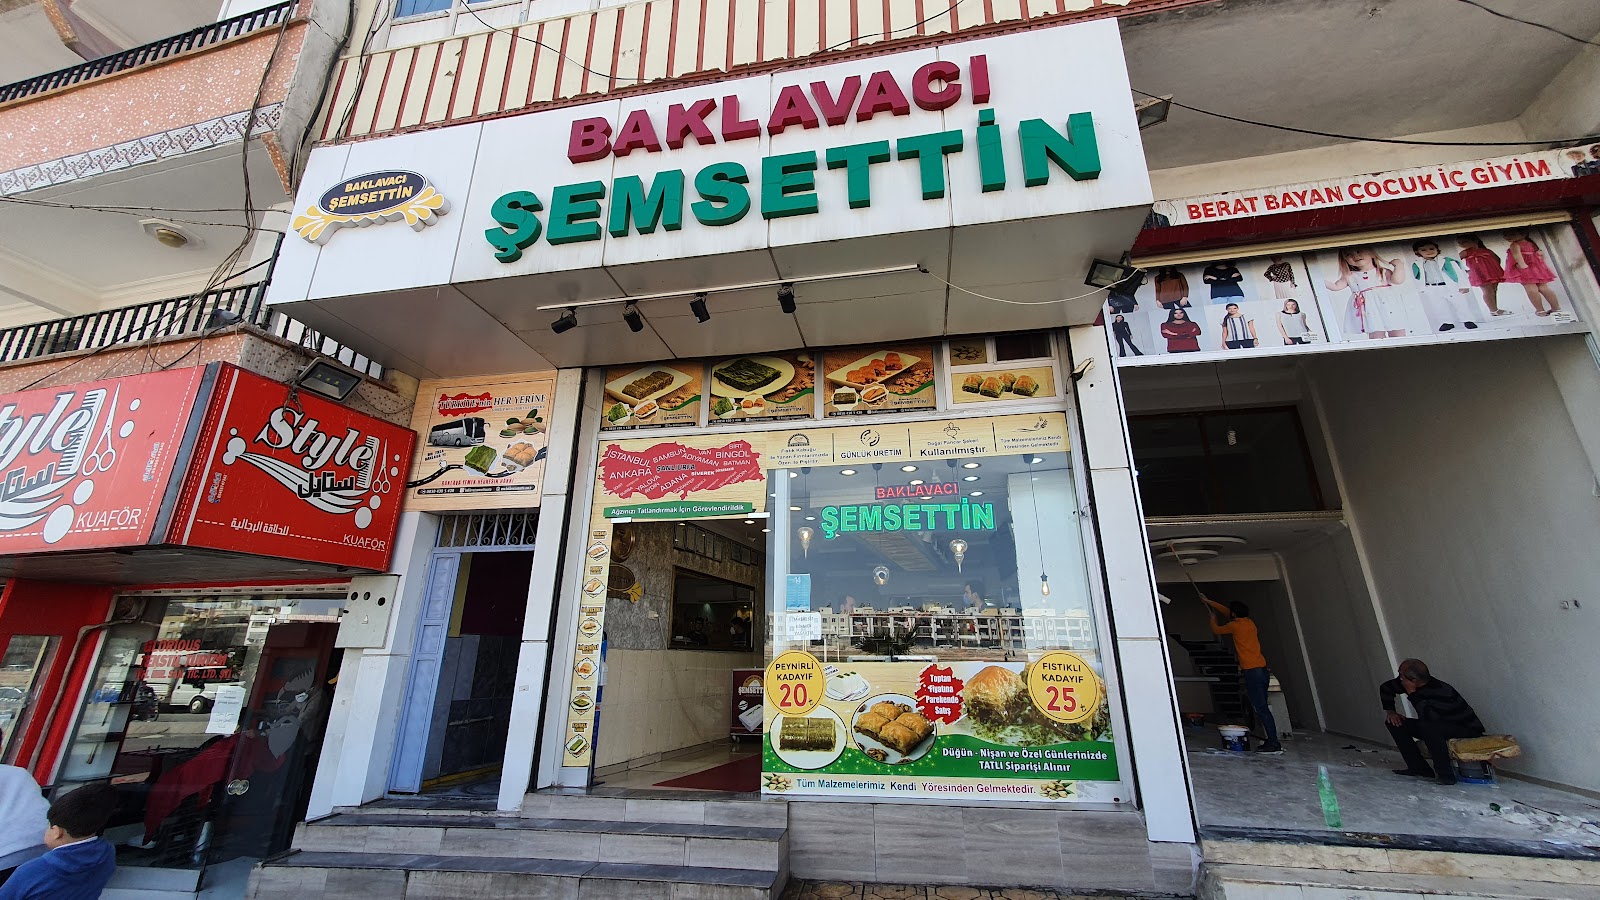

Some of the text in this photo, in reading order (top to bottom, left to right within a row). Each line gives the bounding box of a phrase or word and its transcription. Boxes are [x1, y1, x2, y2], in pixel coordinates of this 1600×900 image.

[566, 54, 991, 164] BAKLAVACI
[344, 175, 407, 193] BAKLAVACI
[484, 108, 1101, 264] ŞEMSETTİN
[1187, 158, 1551, 220] BERAT BAYAN ÇOCUK İÇ GİYİM
[329, 185, 413, 211] ŞEMSETTİN
[493, 397, 512, 406] HER
[514, 392, 546, 404] YERİNE
[0, 391, 93, 472] tyle
[254, 406, 373, 470] Style
[608, 449, 651, 468] İSTANBUL
[652, 448, 686, 464] SAMSUN
[682, 452, 720, 466] ADIYAMAN
[716, 450, 750, 458] BİNGÖL
[840, 449, 902, 459] GÜNLÜK ÜRETİM
[920, 446, 988, 456] Kullanılmıştır.
[609, 468, 652, 480] ANKARA
[660, 472, 688, 492] ADANA
[297, 471, 355, 498] ستايل
[636, 474, 660, 491] YALOVA
[876, 482, 958, 499] BAKLAVACI
[76, 506, 141, 528] KUAFÖR
[611, 508, 636, 516] Ağzınızı
[679, 505, 690, 514] İçin
[692, 504, 745, 512] Görevlendirildik
[230, 517, 263, 534] الرجالية
[820, 497, 995, 540] ŞEMSETTİN
[343, 533, 386, 549] KUAFÖR
[144, 640, 201, 653] GLORIOUS
[775, 660, 814, 670] PEYNİRLİ
[1042, 662, 1082, 672] FISTIKLI
[202, 670, 217, 678] LTD.
[776, 673, 814, 682] KADAYIF
[930, 674, 952, 683] Toptan
[1041, 673, 1084, 684] KADAYIF
[738, 686, 764, 696] ŞEMSETT
[779, 683, 808, 708] 20
[929, 684, 954, 694] Fiyatına
[1046, 686, 1077, 712] 25
[935, 706, 951, 716] Satış
[942, 748, 973, 759] Düğün
[980, 748, 1007, 760] Nişan
[1022, 747, 1043, 758] Özel
[1044, 749, 1108, 760] Günlerinizde
[979, 760, 1071, 773] TATLI Siparişi Alınır
[796, 778, 1036, 794] Tüm Malzemelerimiz Kendi Yöresinden Gelmektedir.
